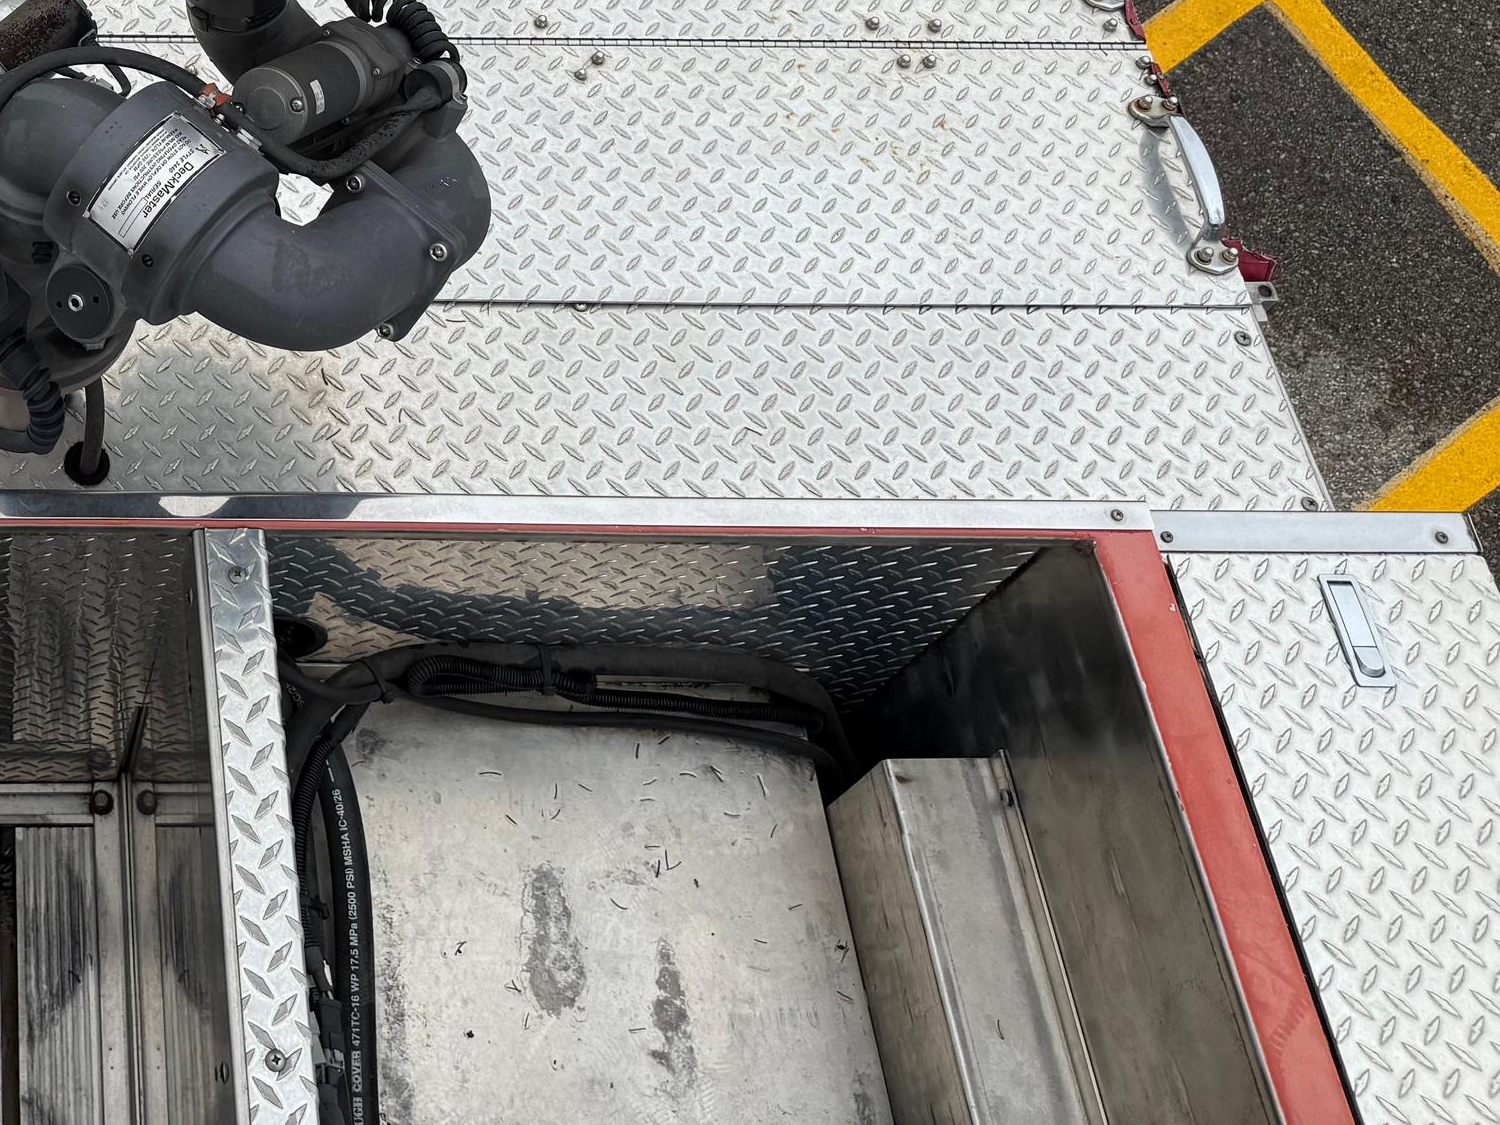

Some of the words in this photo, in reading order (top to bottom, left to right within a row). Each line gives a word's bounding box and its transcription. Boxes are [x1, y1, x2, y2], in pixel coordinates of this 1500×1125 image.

[144, 144, 166, 166] PRESSURE
[155, 142, 177, 163] OPERATING
[178, 148, 195, 162] STYLE
[130, 161, 157, 193] INSTRUCTIONS
[145, 164, 162, 182] DEPLOY
[134, 180, 147, 195] WHILE
[140, 161, 194, 219] DeckMaster
[143, 180, 162, 200] SERIAL
[117, 191, 132, 210] BEFORE
[120, 194, 137, 215] FLOWING
[111, 209, 119, 219] USE
[331, 788, 348, 832] IC-40/26
[340, 832, 353, 866] MSHA
[345, 866, 357, 889] PSI)
[347, 891, 358, 921] (2500
[349, 922, 359, 947] MPa
[350, 948, 359, 970] 17.5
[350, 973, 359, 993] WP
[350, 994, 361, 1047] 471TC-16
[351, 1050, 362, 1093] COVER
